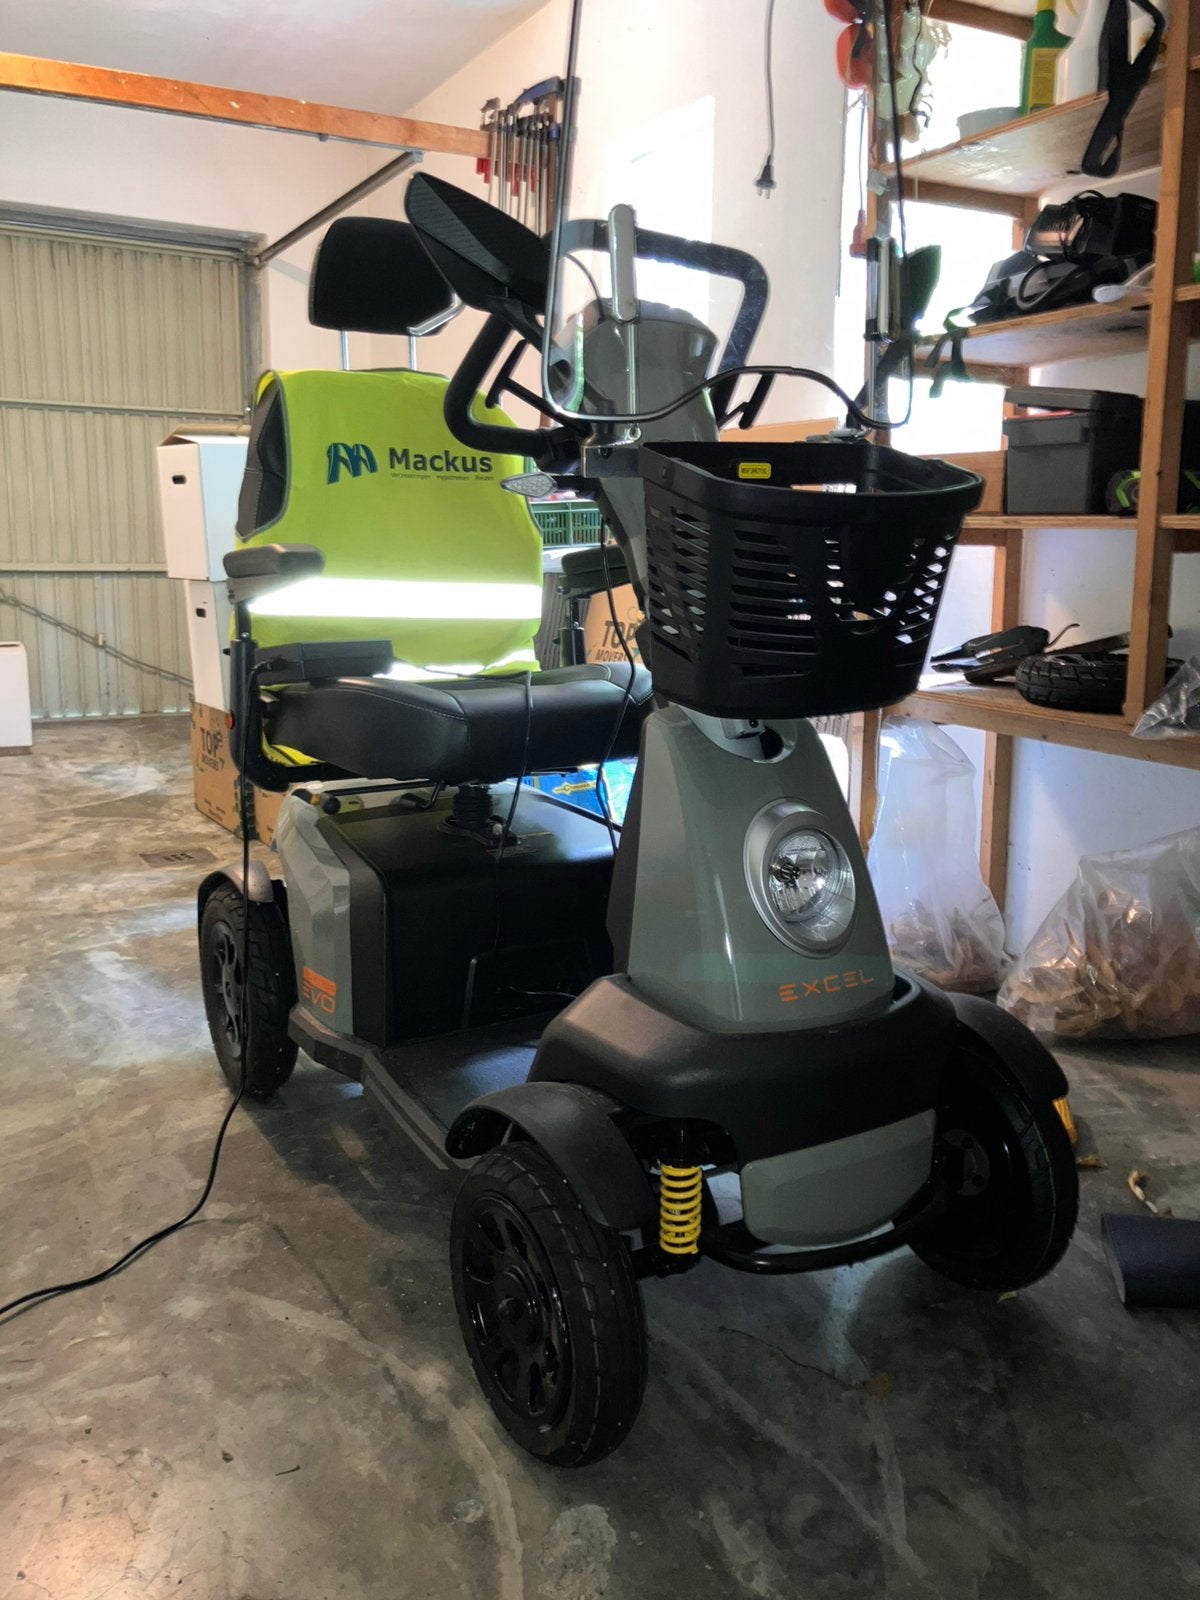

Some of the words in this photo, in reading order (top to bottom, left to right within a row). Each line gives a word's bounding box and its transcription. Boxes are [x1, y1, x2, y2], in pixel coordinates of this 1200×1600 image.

[388, 447, 493, 473] Mackus
[602, 620, 636, 649] TOP
[303, 980, 336, 1014] EVO
[778, 969, 875, 1003] EXCEL
